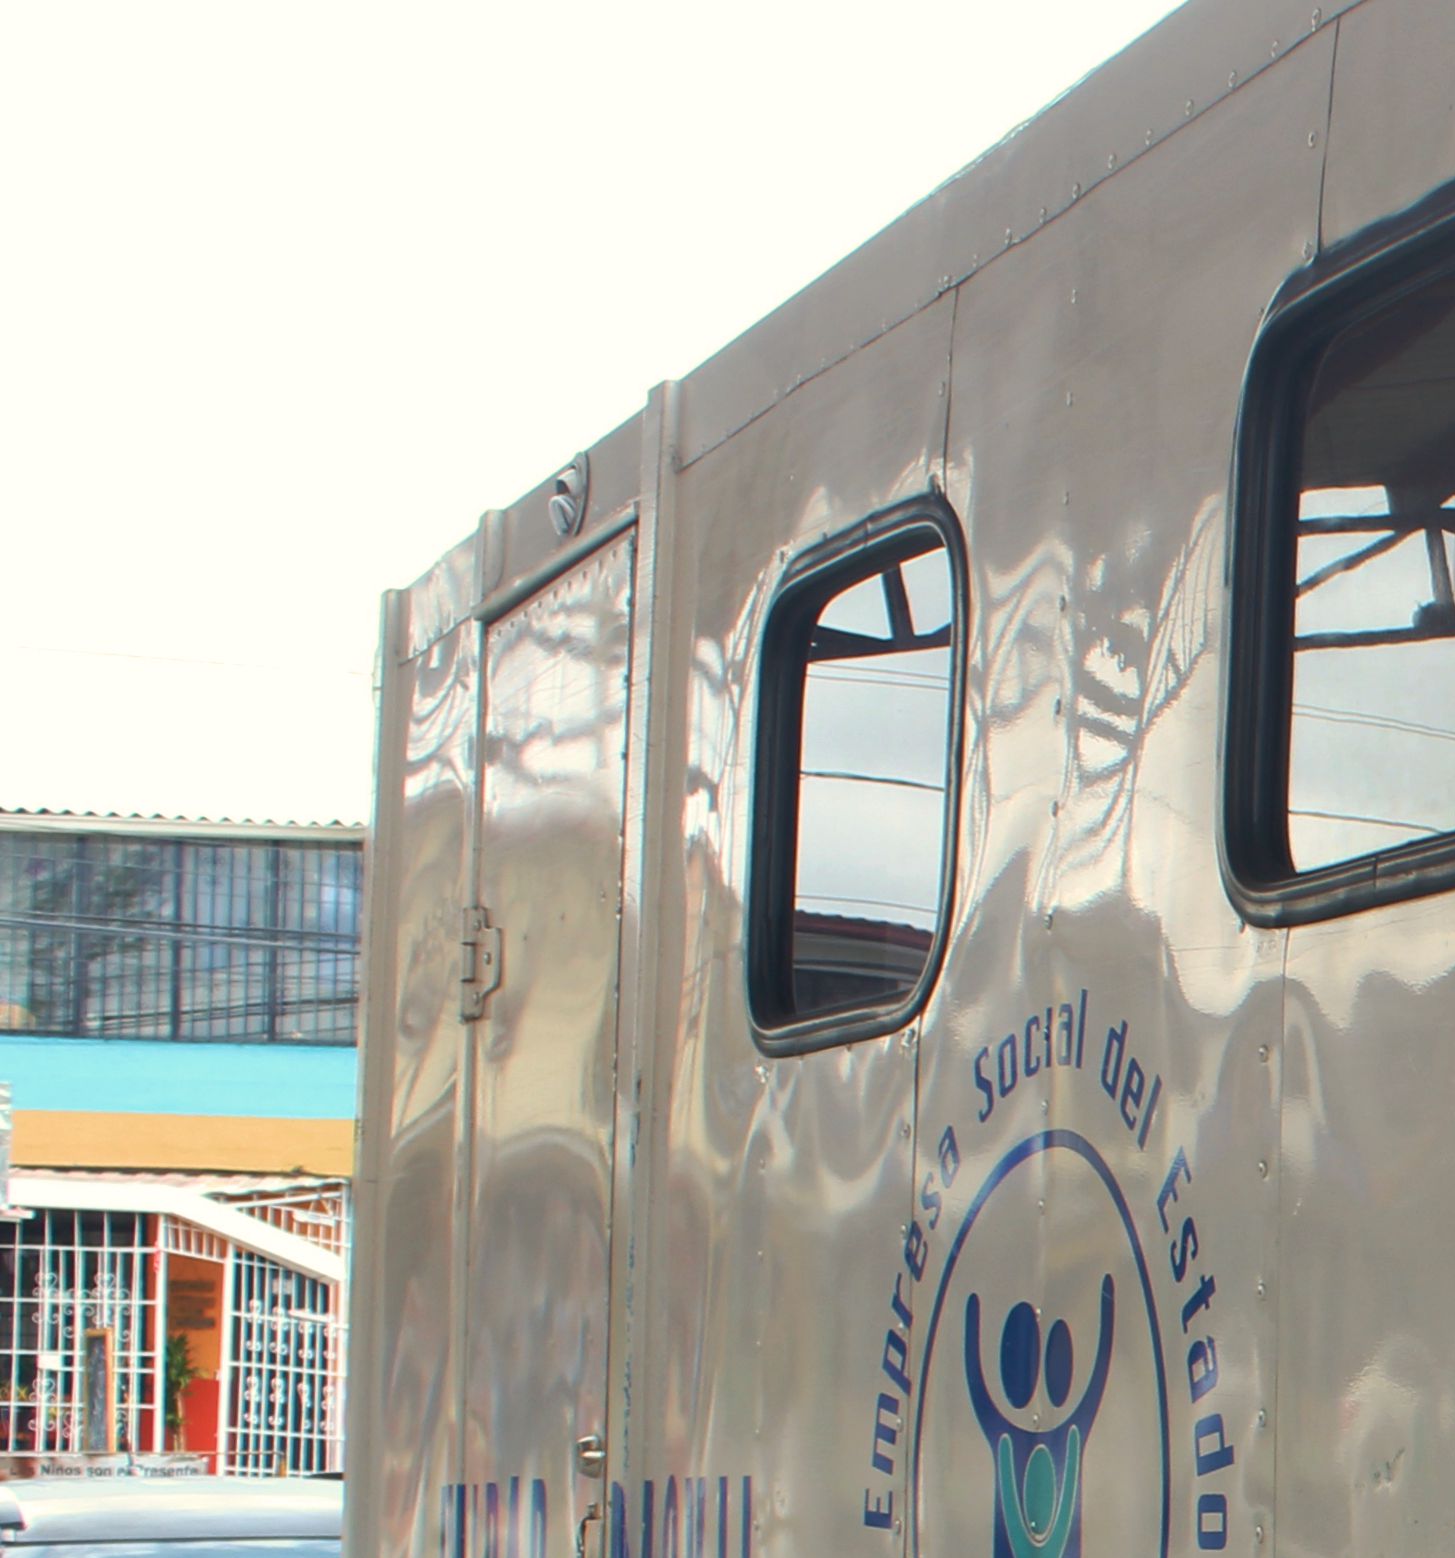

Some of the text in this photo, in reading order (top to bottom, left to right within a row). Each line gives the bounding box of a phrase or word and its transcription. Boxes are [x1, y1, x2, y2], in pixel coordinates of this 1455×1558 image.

[864, 988, 1235, 1551] Empresa Social del Estado
